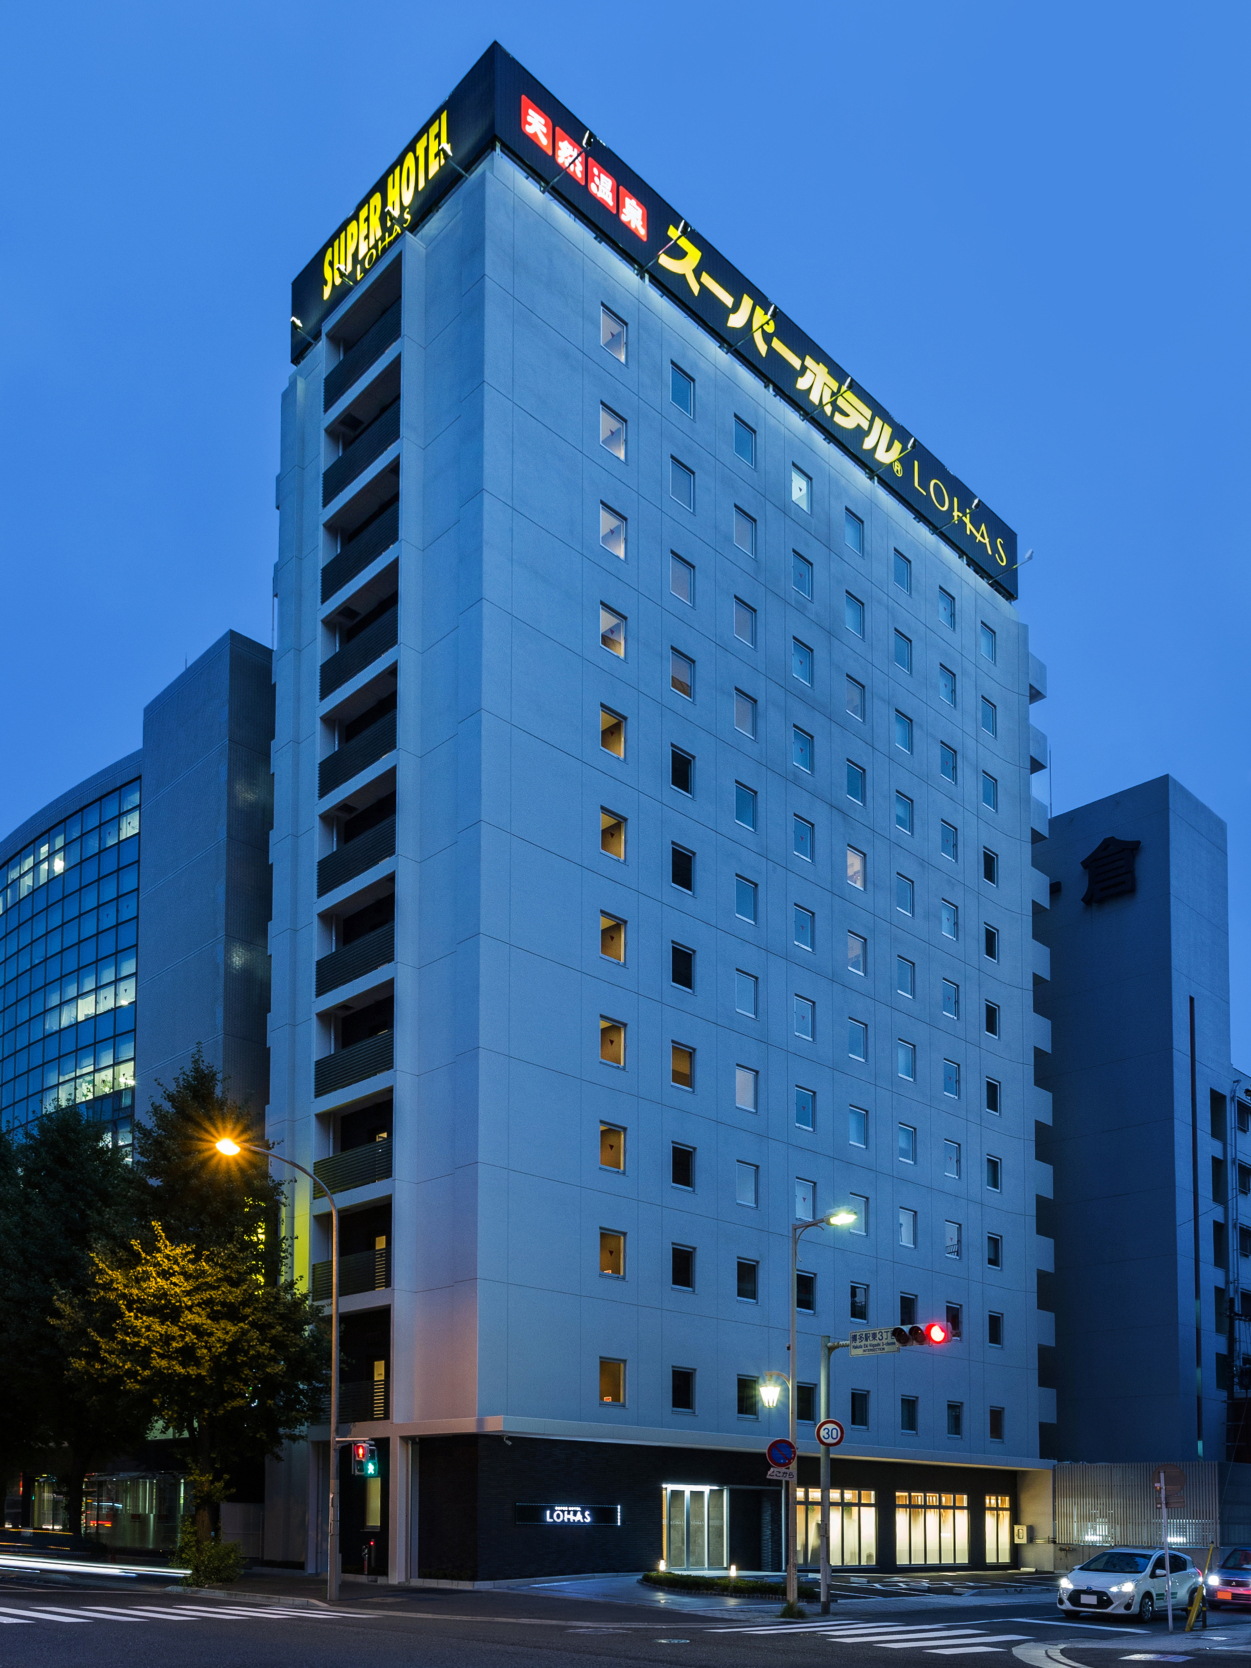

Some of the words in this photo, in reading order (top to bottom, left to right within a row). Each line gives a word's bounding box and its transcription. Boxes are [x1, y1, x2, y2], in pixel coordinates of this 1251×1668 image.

[322, 192, 382, 301] SUPER
[386, 110, 451, 227] HOTEL
[525, 108, 646, 236] 天然温泉
[356, 208, 411, 281] LOHAS
[658, 225, 902, 464] スーパーホテル
[914, 460, 1007, 566] LOHAS
[822, 1427, 839, 1440] 30
[546, 1510, 591, 1523] LOHAS
